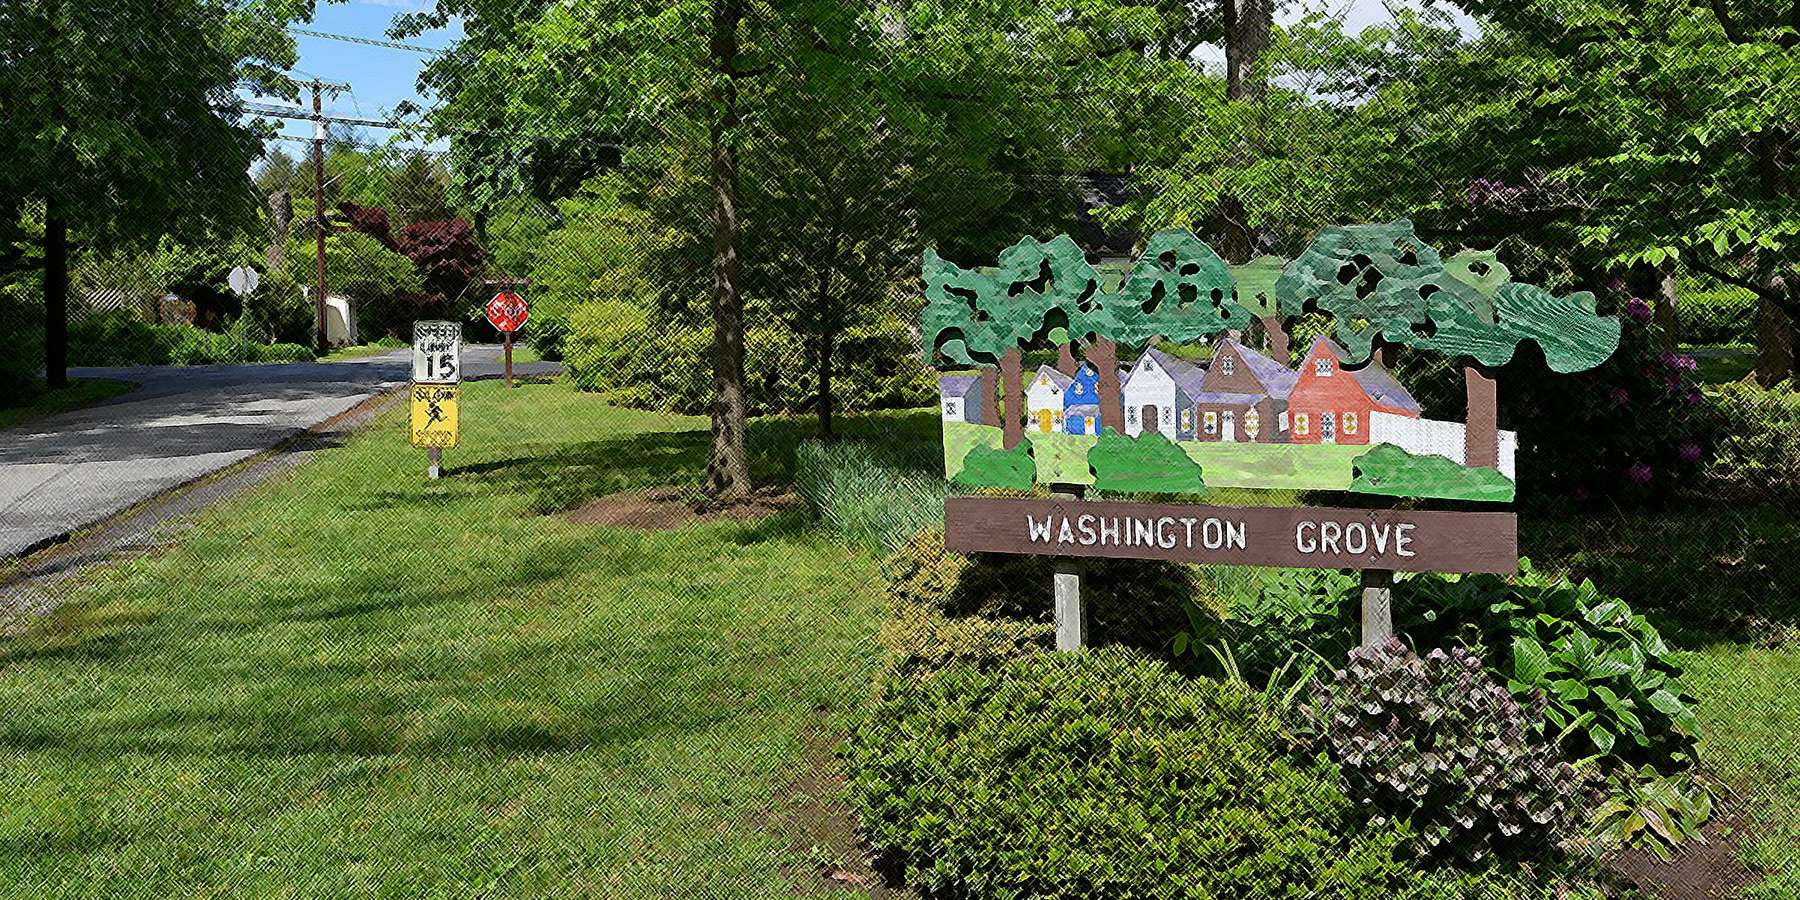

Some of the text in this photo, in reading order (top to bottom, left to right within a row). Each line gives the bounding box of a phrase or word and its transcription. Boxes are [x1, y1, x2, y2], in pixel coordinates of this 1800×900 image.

[427, 354, 456, 379] 15
[1027, 514, 1416, 557] WASHINGTON GROVE
